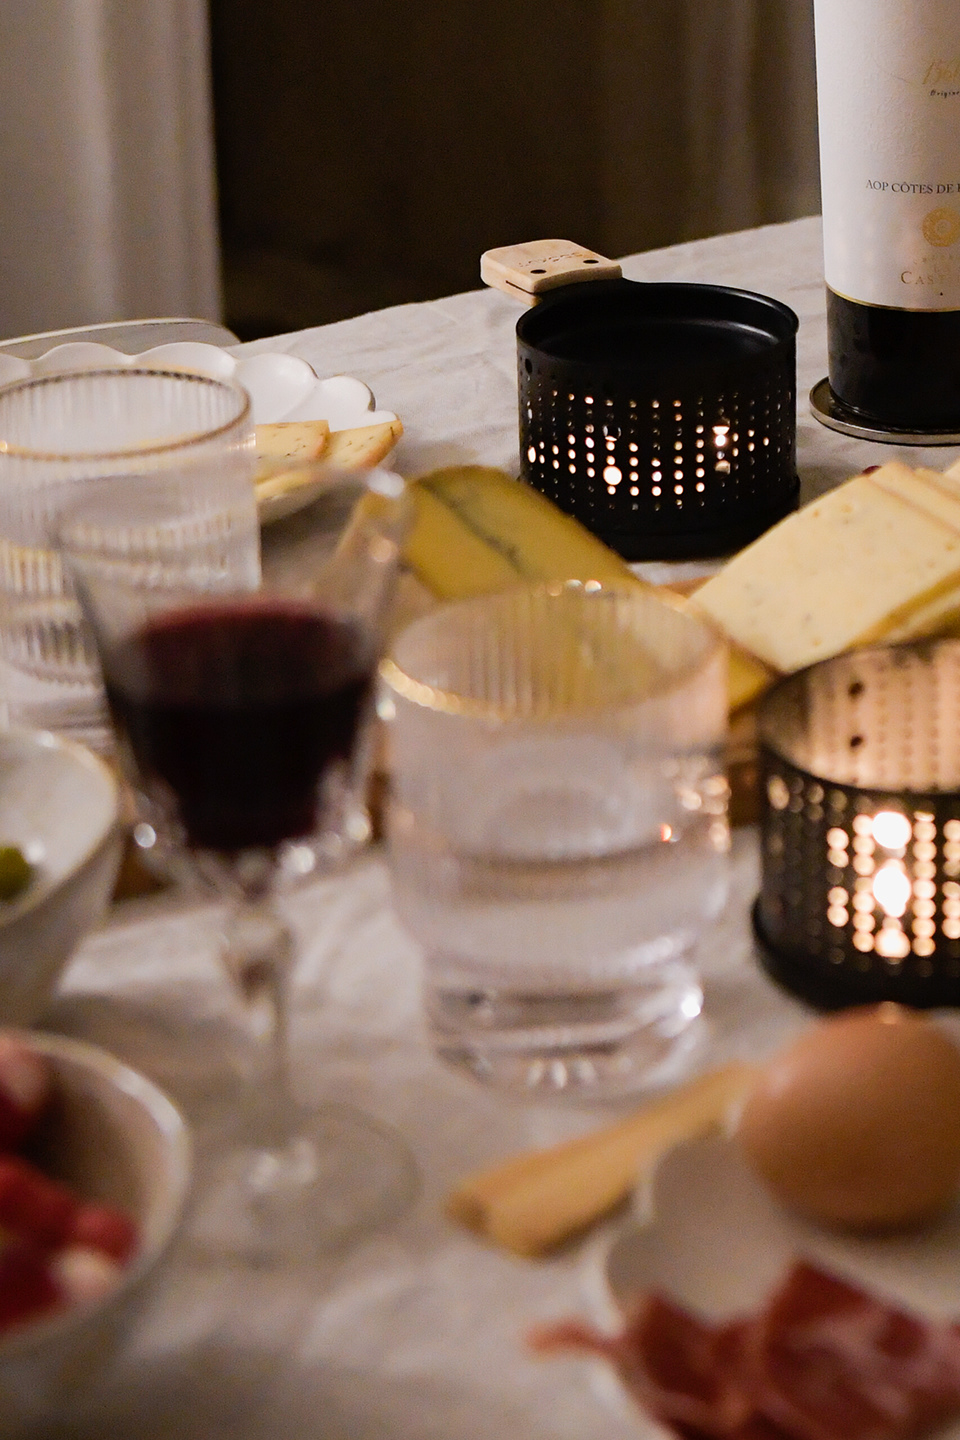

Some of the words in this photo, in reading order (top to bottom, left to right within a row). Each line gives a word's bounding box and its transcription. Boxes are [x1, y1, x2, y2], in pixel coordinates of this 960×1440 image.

[866, 179, 889, 191] AOP
[891, 181, 934, 195] CÔTES
[936, 184, 955, 194] DE
